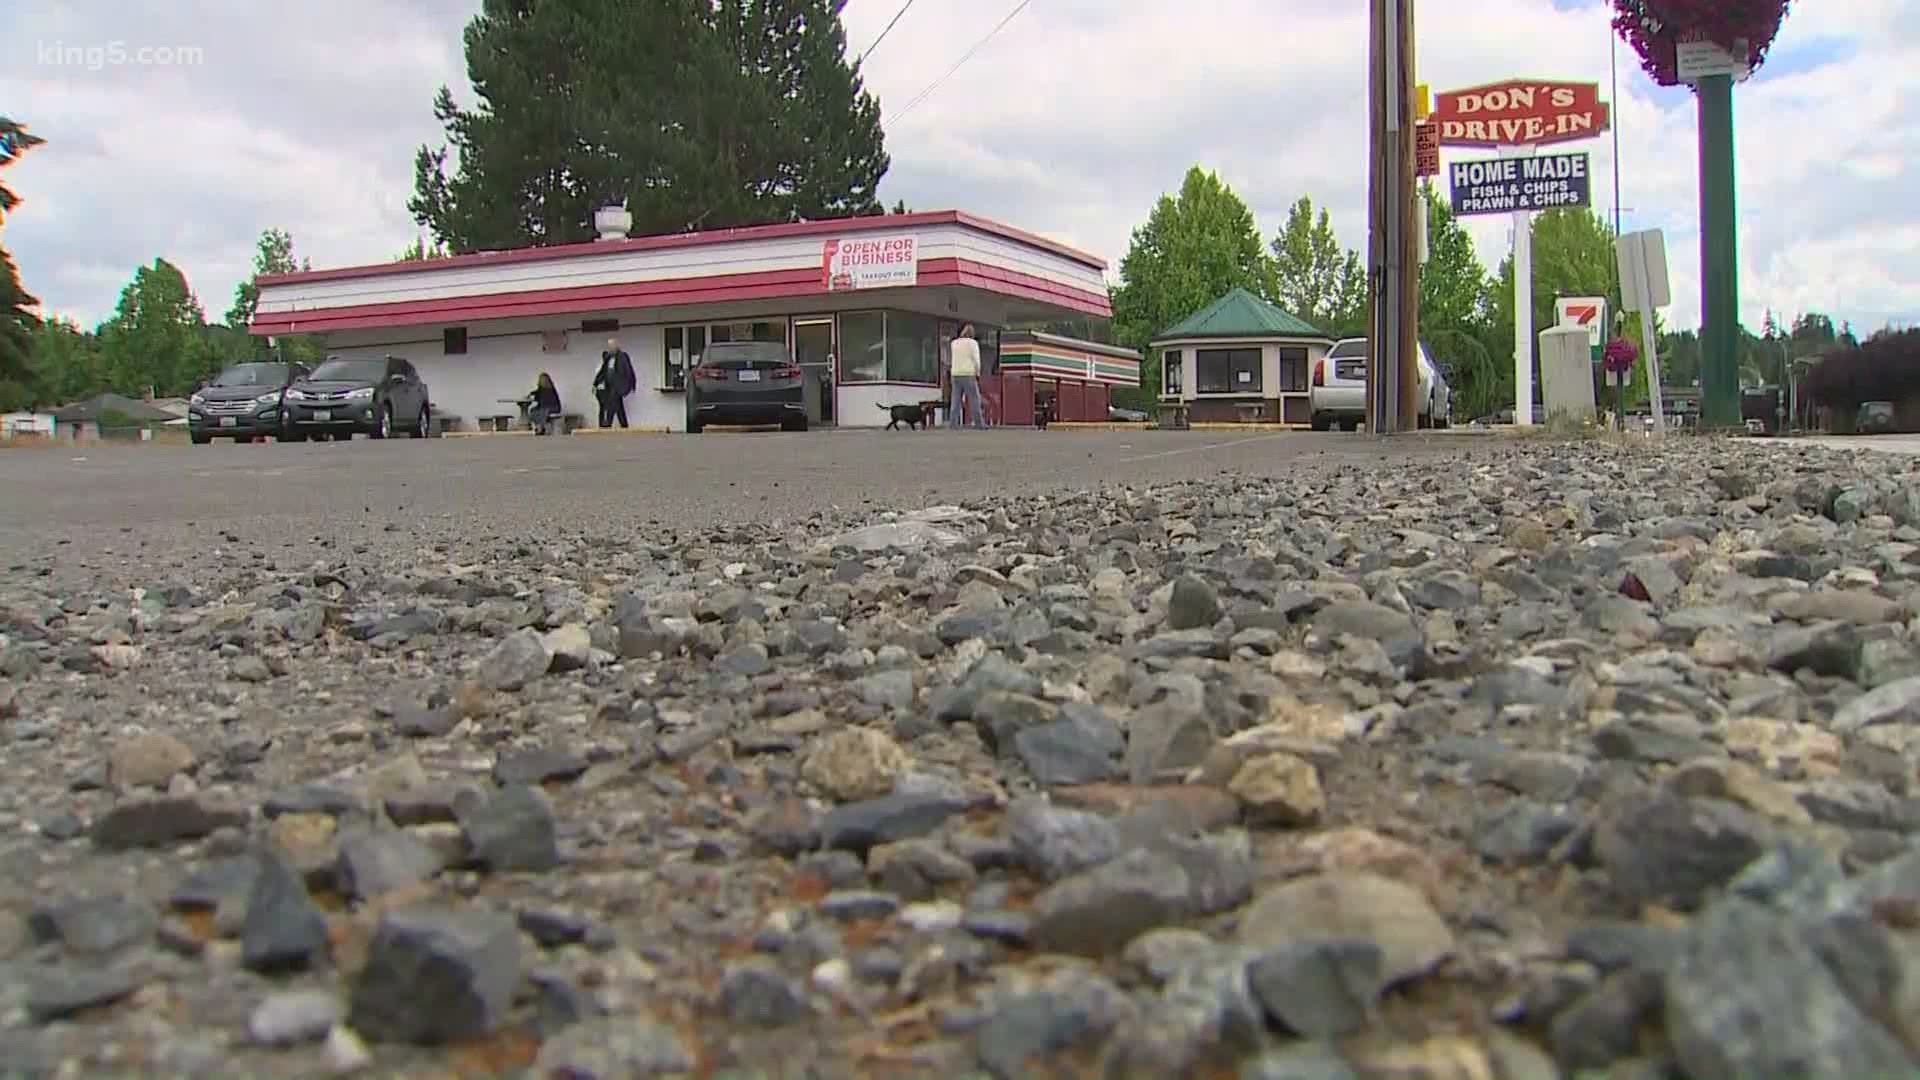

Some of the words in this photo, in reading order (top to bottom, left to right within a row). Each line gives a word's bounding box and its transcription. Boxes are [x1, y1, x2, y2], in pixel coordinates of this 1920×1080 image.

[1456, 86, 1575, 114] DON'S
[1442, 112, 1593, 142] DRIVE-IN
[1453, 161, 1516, 187] HOME
[1523, 156, 1585, 179] MADE
[1471, 184, 1504, 198] FISH
[1509, 183, 1521, 195] &
[1524, 180, 1568, 194] CHIPS
[1462, 197, 1515, 210] PRAWN
[1519, 196, 1531, 207] &
[1533, 191, 1578, 205] CHIPS
[842, 240, 880, 254] OPEN
[884, 238, 913, 251] FOR
[841, 250, 913, 266] BUSINESS
[1566, 305, 1597, 325] 7
